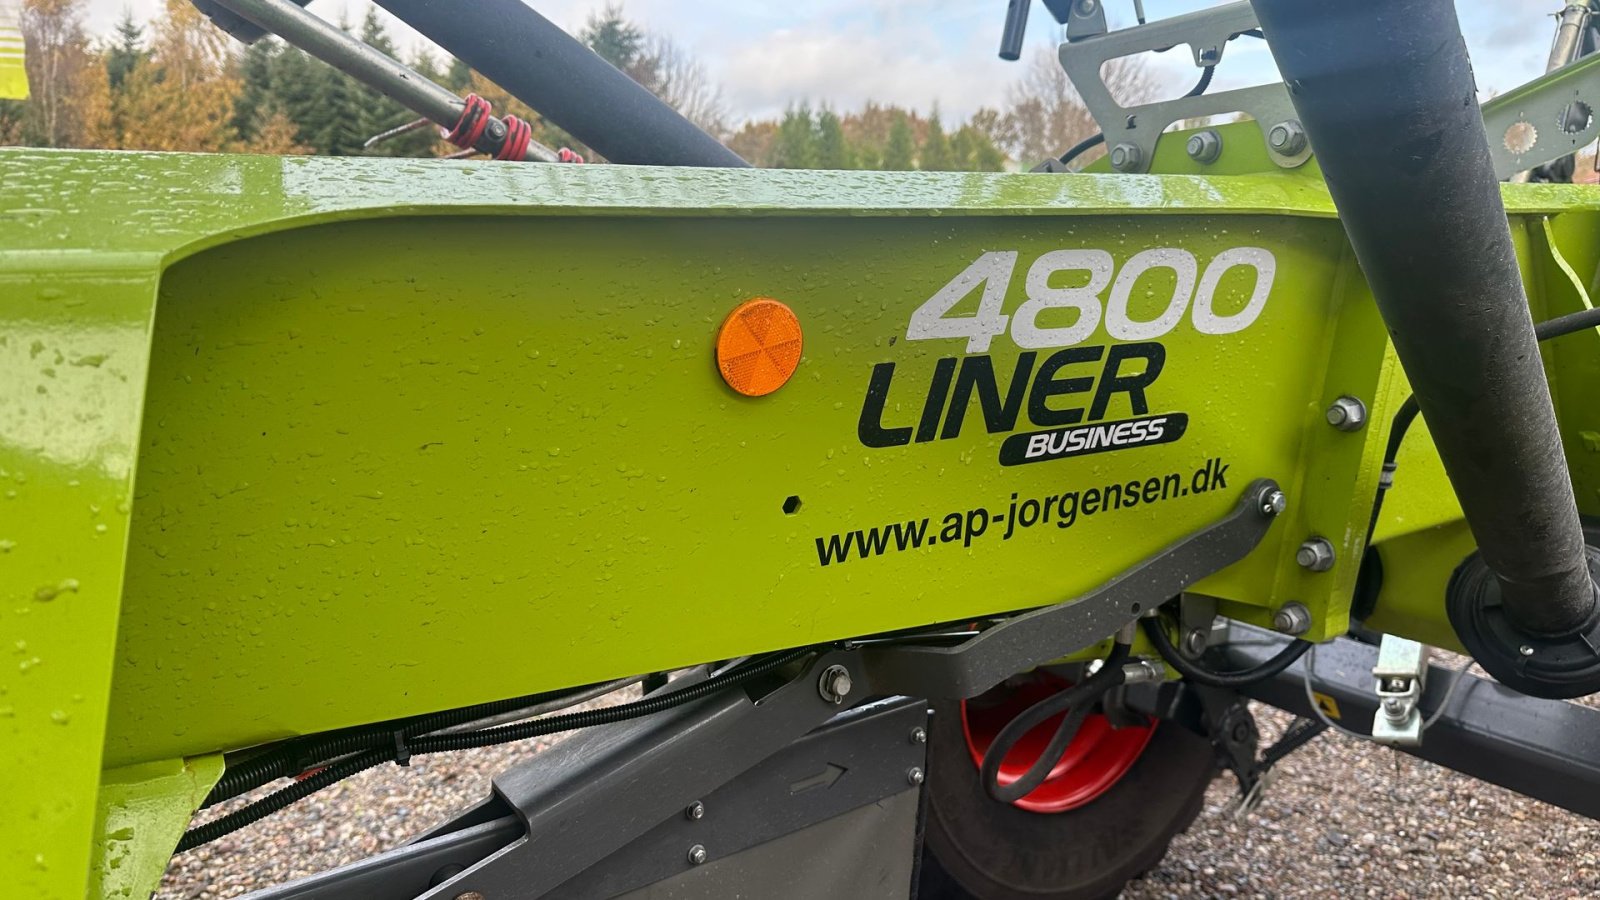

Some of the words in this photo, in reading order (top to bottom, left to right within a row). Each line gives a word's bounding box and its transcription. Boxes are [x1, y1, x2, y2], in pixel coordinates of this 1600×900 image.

[906, 247, 1276, 353] 4800
[858, 342, 1166, 448] LINER
[1025, 417, 1167, 458] BUSINESS
[815, 458, 1230, 567] www.ap-jorgensen.dk
